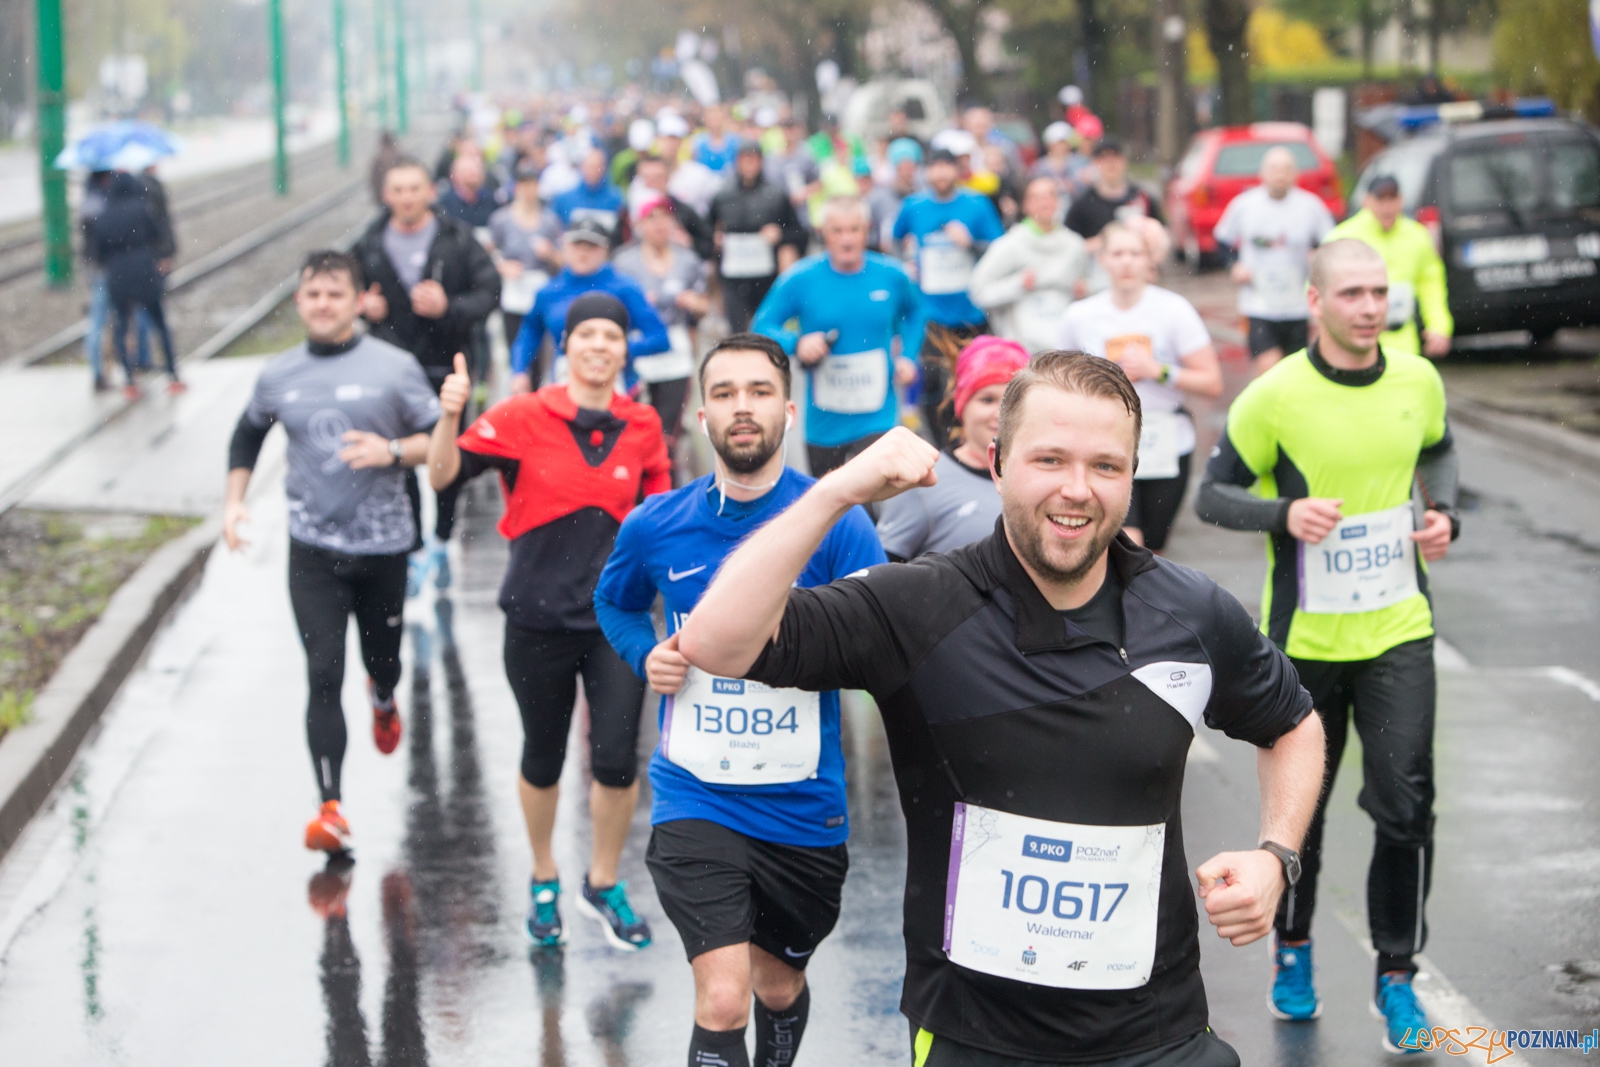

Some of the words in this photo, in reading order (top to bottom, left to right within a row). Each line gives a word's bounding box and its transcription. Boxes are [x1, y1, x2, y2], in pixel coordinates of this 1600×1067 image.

[1323, 538, 1403, 573] 10384
[723, 682, 741, 692] PKO
[693, 703, 798, 735] 13084
[1040, 843, 1065, 857] PKO
[1001, 869, 1129, 922] 10617
[1026, 922, 1094, 940] Waldemar
